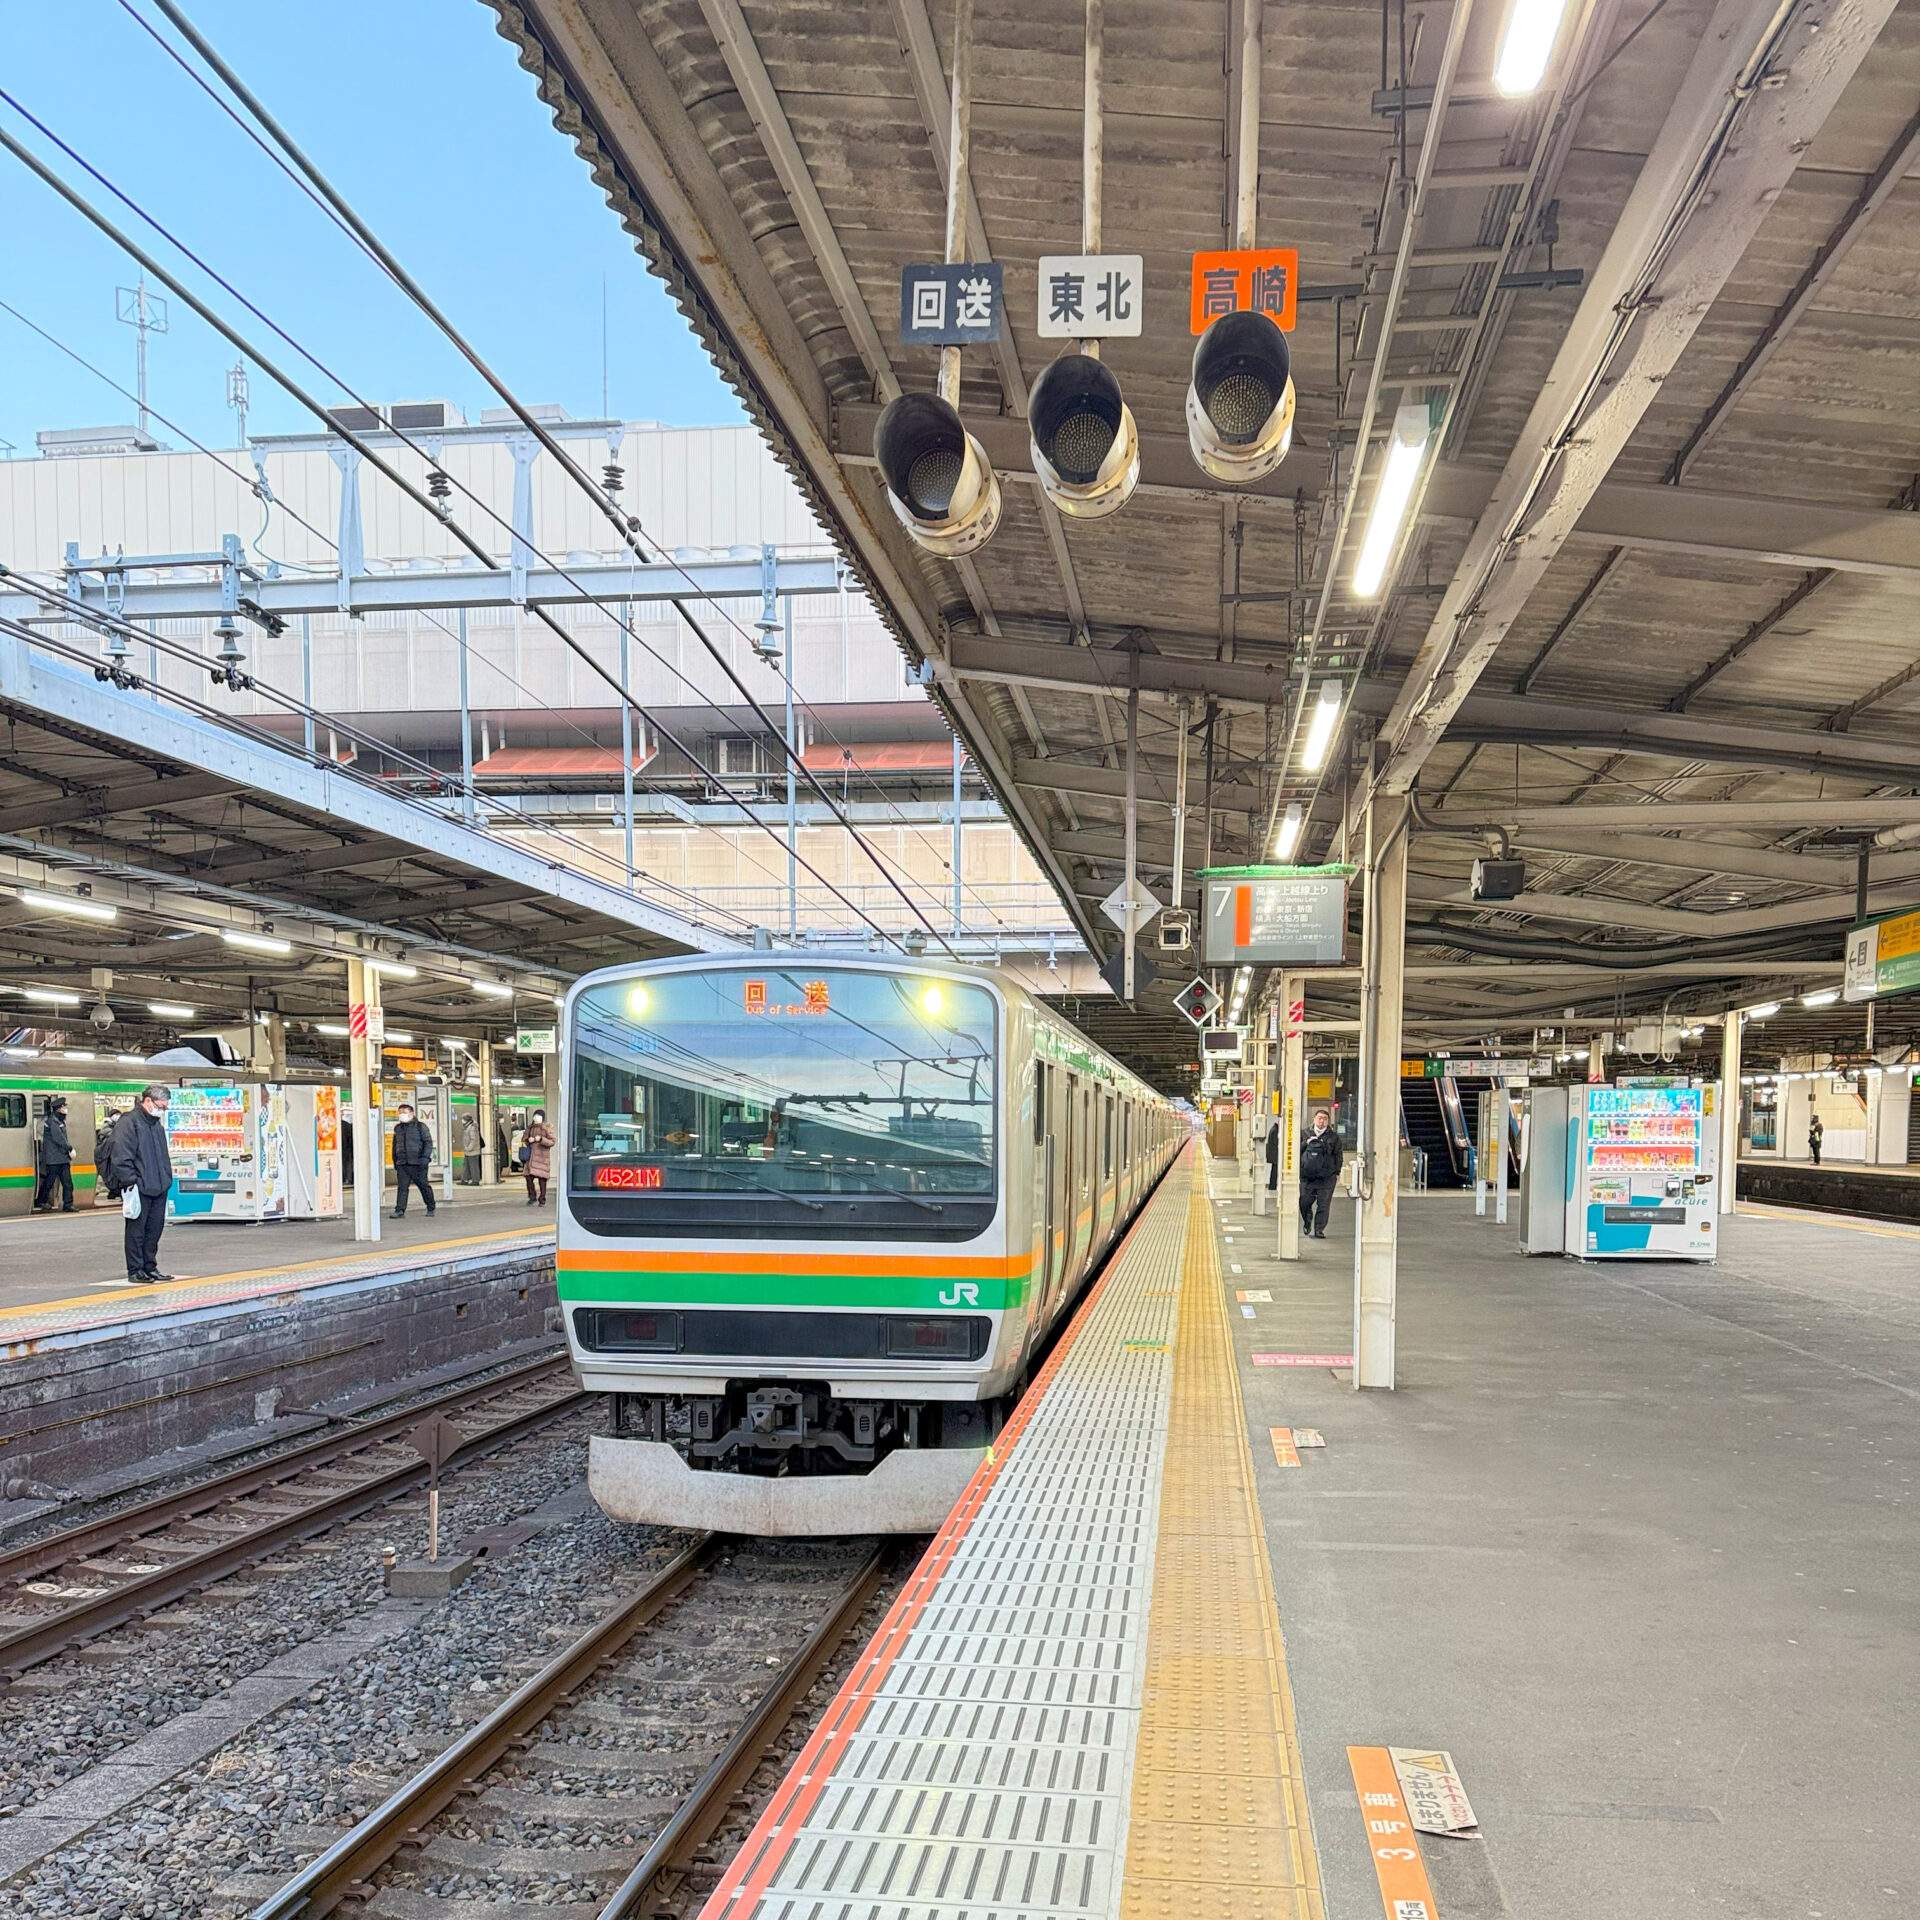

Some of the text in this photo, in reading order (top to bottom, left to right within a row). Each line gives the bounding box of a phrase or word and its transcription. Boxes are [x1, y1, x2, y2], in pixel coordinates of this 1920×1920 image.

[911, 277, 993, 331] 回送
[1048, 271, 1131, 323] 東北
[1203, 264, 1287, 320] 高崎
[1212, 886, 1232, 917] 7
[744, 980, 830, 1006] 回送
[746, 1004, 827, 1015] Out of Service
[598, 1167, 661, 1188] 4521M
[1674, 1198, 1709, 1206] acure
[939, 1282, 979, 1306] JR
[1405, 1771, 1449, 1830] 止まりません
[1362, 1791, 1417, 1862] 3号車
